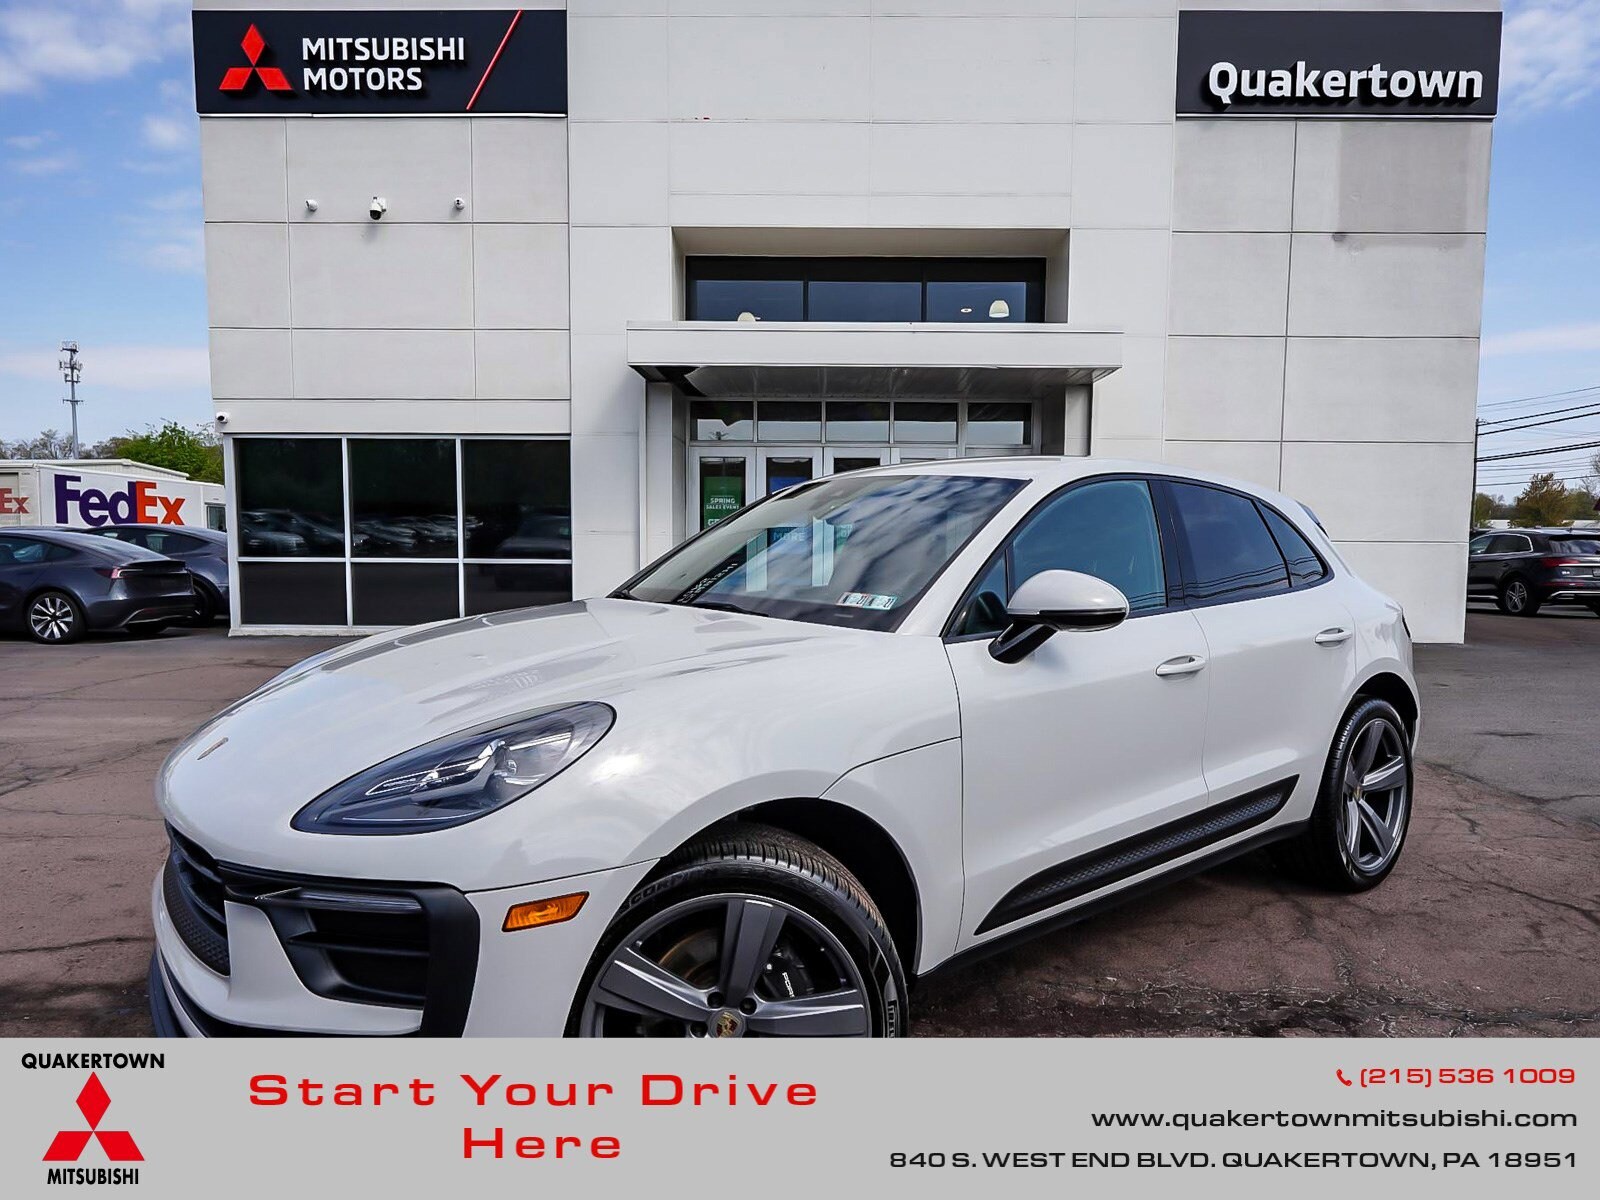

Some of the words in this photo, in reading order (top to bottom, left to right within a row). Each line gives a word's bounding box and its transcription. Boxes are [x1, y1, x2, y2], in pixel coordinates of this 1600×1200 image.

[302, 37, 465, 62] MITSUBISHI
[303, 67, 424, 92] MOTORS
[1208, 61, 1484, 105] Quakertown
[54, 474, 186, 526] FedEx
